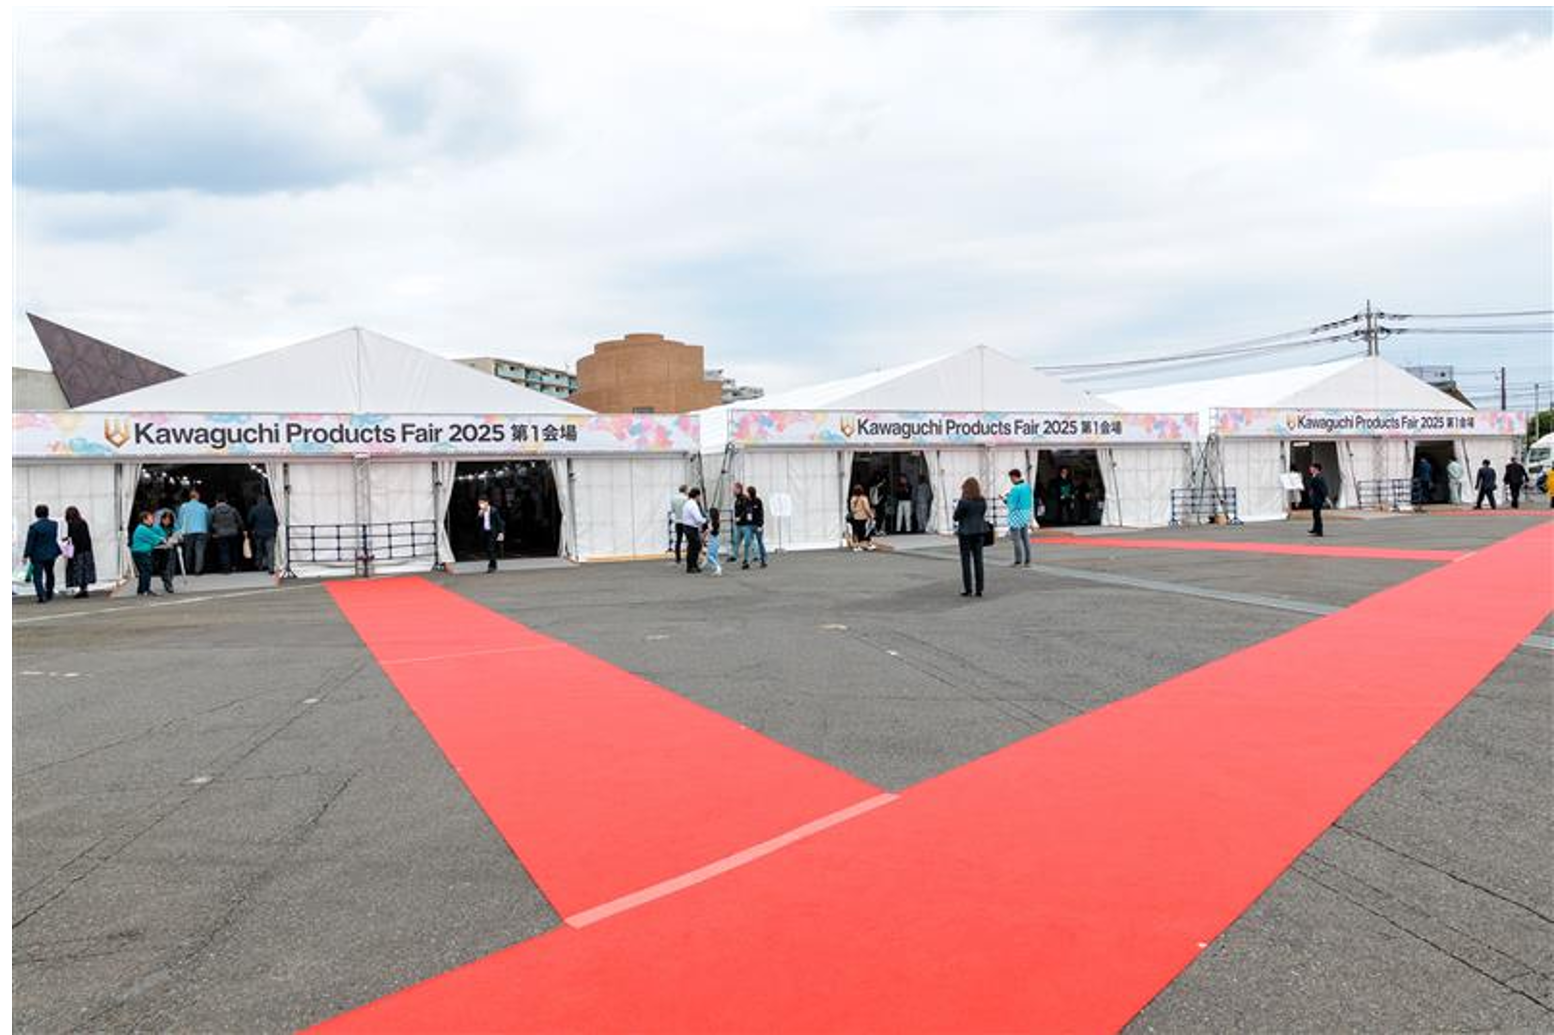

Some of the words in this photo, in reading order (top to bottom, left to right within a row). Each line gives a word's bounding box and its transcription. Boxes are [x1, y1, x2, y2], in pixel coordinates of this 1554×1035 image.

[857, 418, 942, 439] Kawaguchi
[946, 419, 1011, 436] Products
[1014, 419, 1039, 435] Fair
[1043, 420, 1078, 435] 2025
[1297, 415, 1354, 432] Kawaguchi
[1355, 415, 1399, 429] Products
[1401, 416, 1419, 429] Fair
[1420, 416, 1444, 429] 2025
[134, 423, 280, 449] Kawaguchi
[286, 423, 396, 444] Products
[401, 423, 443, 443] Fair
[449, 424, 505, 442] 2025
[511, 424, 577, 442] 第1会場
